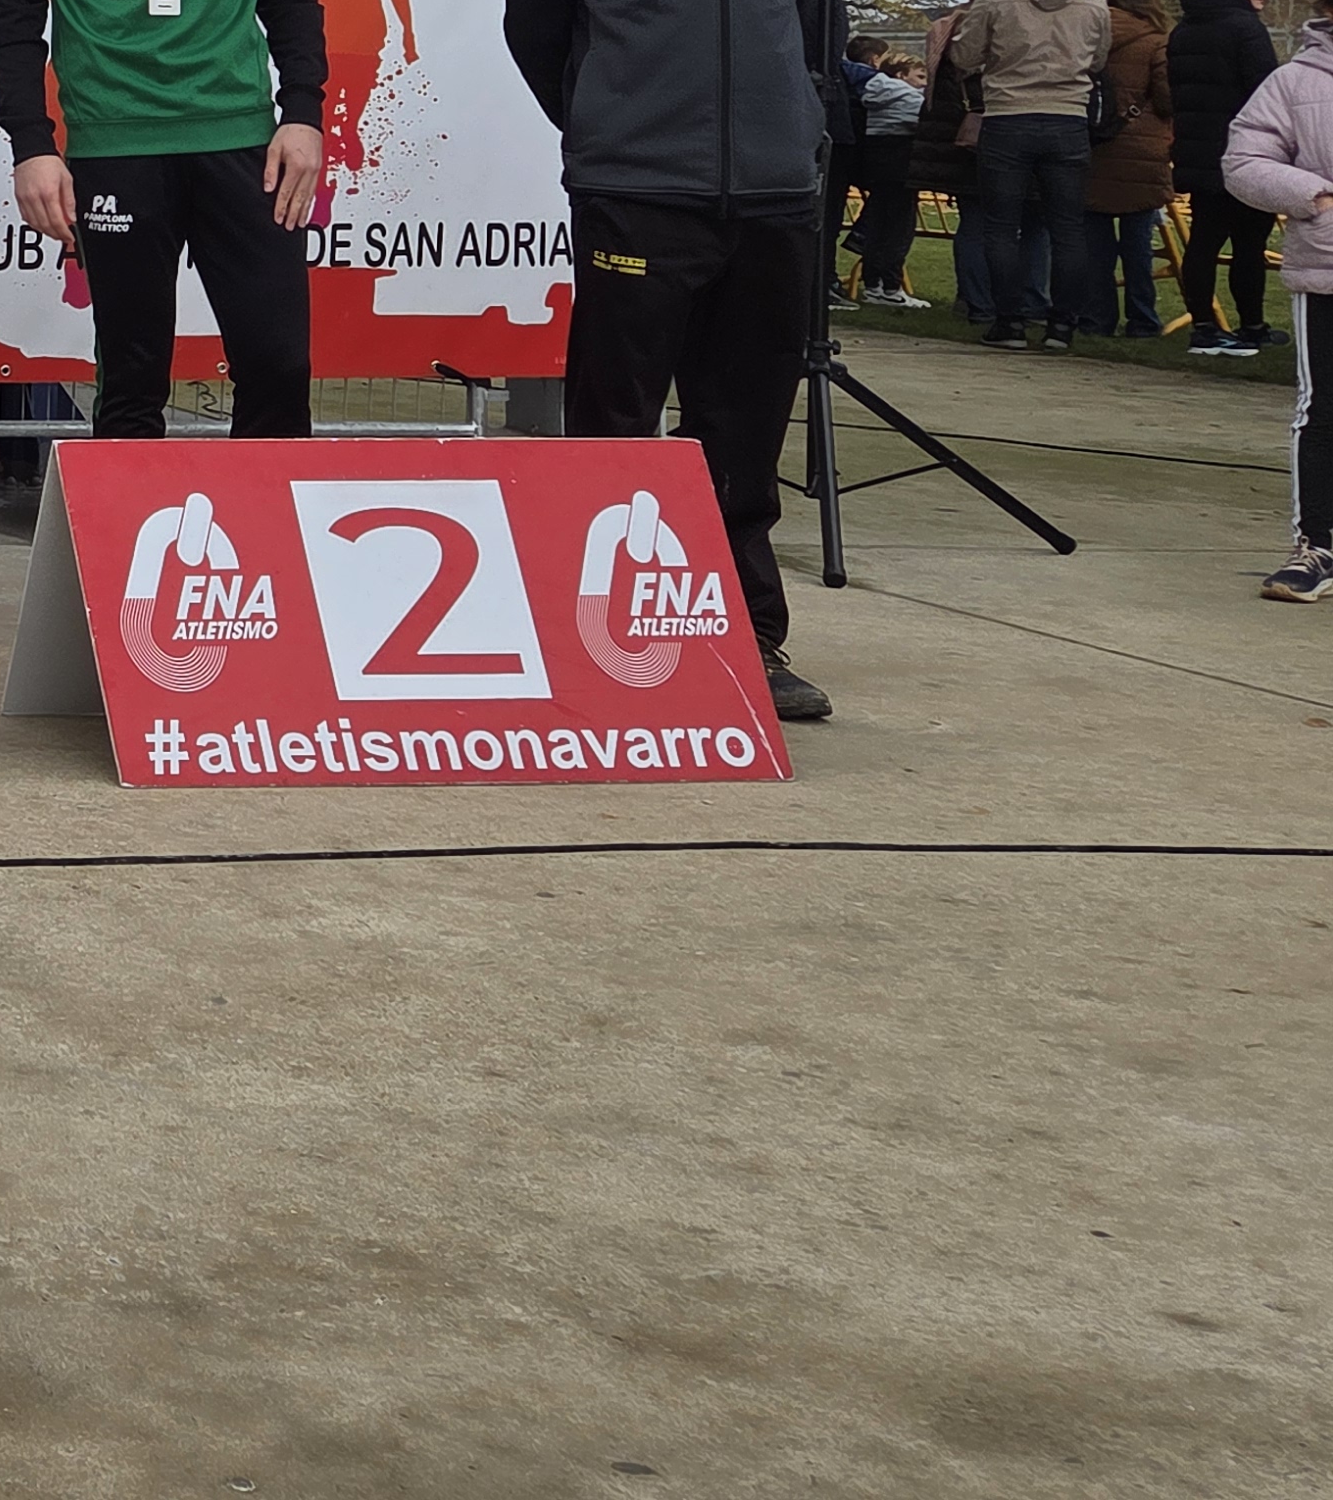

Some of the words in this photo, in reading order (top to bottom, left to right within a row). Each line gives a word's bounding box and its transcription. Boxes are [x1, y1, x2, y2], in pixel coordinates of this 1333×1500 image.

[84, 211, 134, 223] PAMPLONA
[91, 194, 118, 214] PA
[307, 222, 354, 268] DE
[363, 221, 444, 268] SAN
[455, 221, 574, 269] ADRIA
[174, 574, 278, 621] FNA
[327, 506, 527, 677] 2
[628, 571, 728, 618] FNA
[171, 618, 279, 642] ATLETISMO
[626, 615, 730, 639] ATLETISMO
[144, 717, 757, 776] #atletismonavarro
